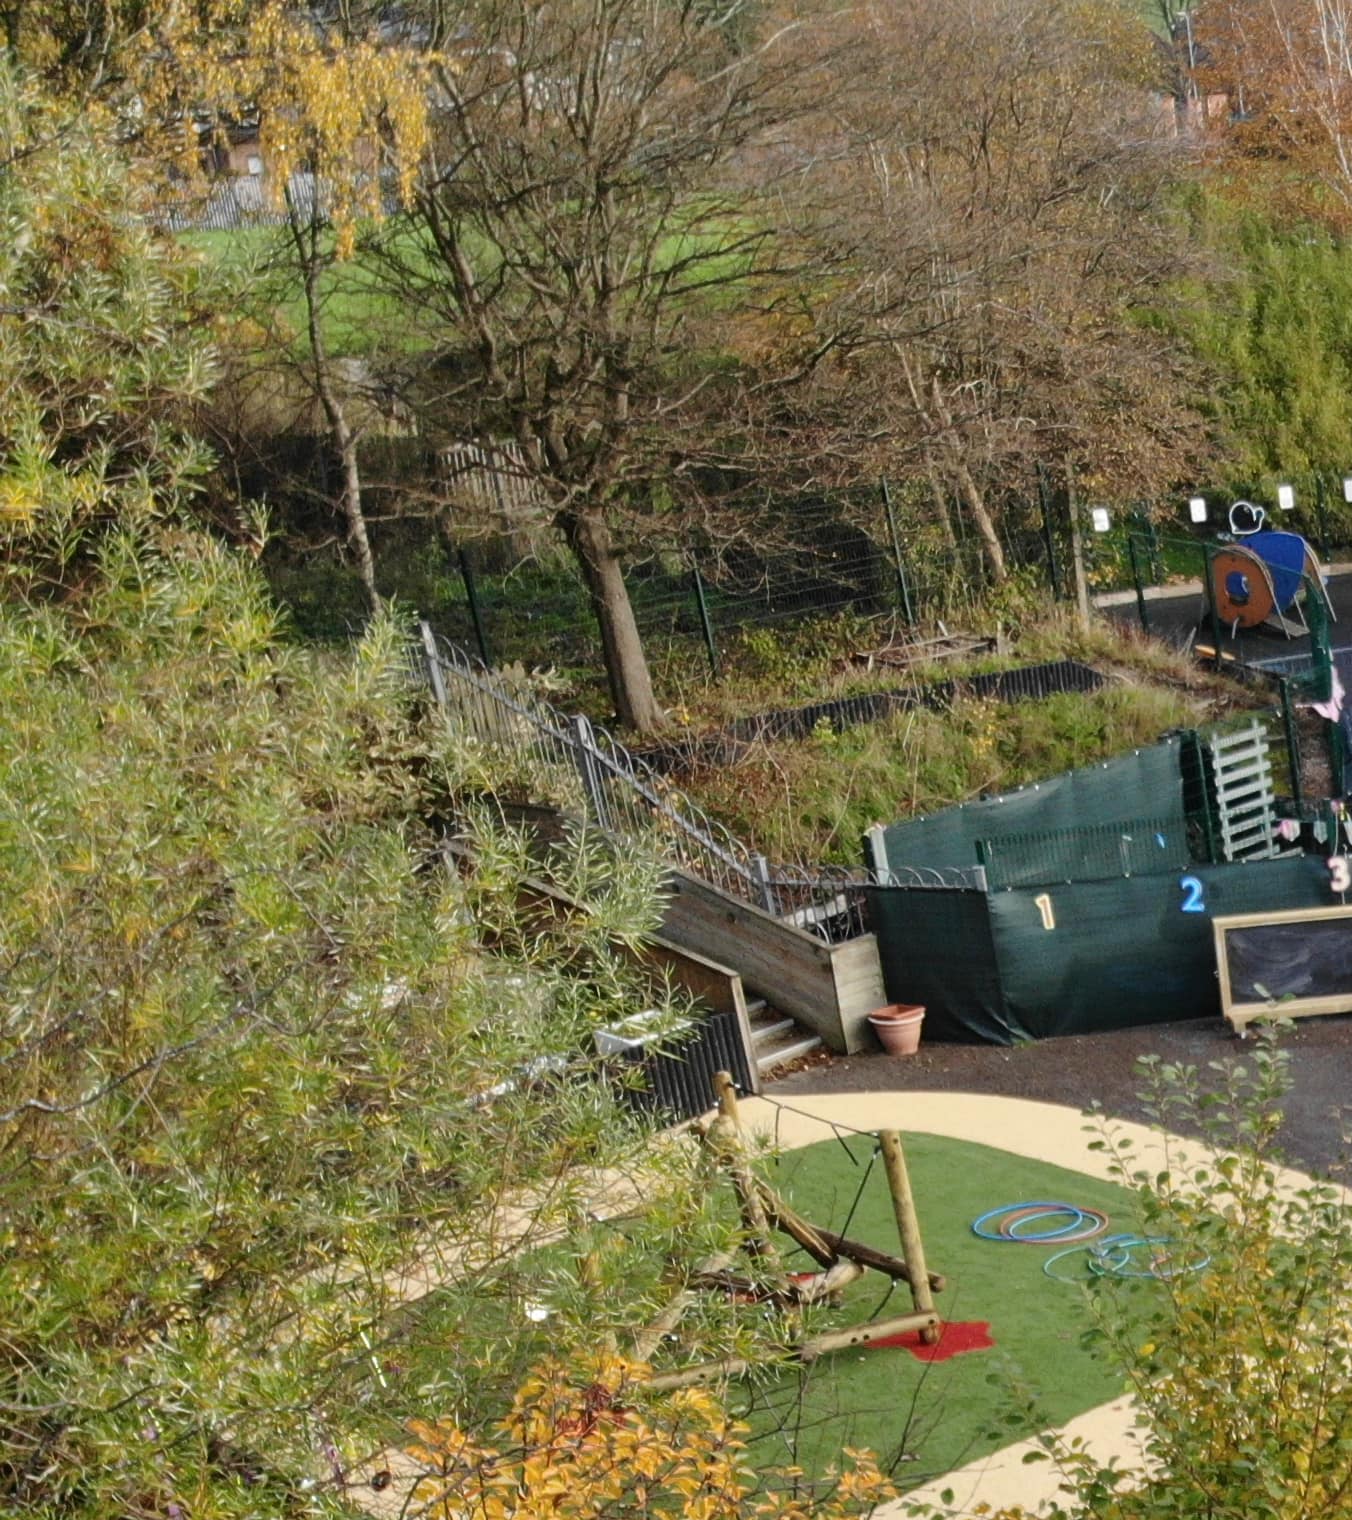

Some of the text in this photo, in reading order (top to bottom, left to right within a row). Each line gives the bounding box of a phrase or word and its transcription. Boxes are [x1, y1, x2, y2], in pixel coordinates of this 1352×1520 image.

[1033, 893, 1055, 930] 1
[1180, 876, 1206, 913] 2
[1327, 855, 1351, 892] 3
